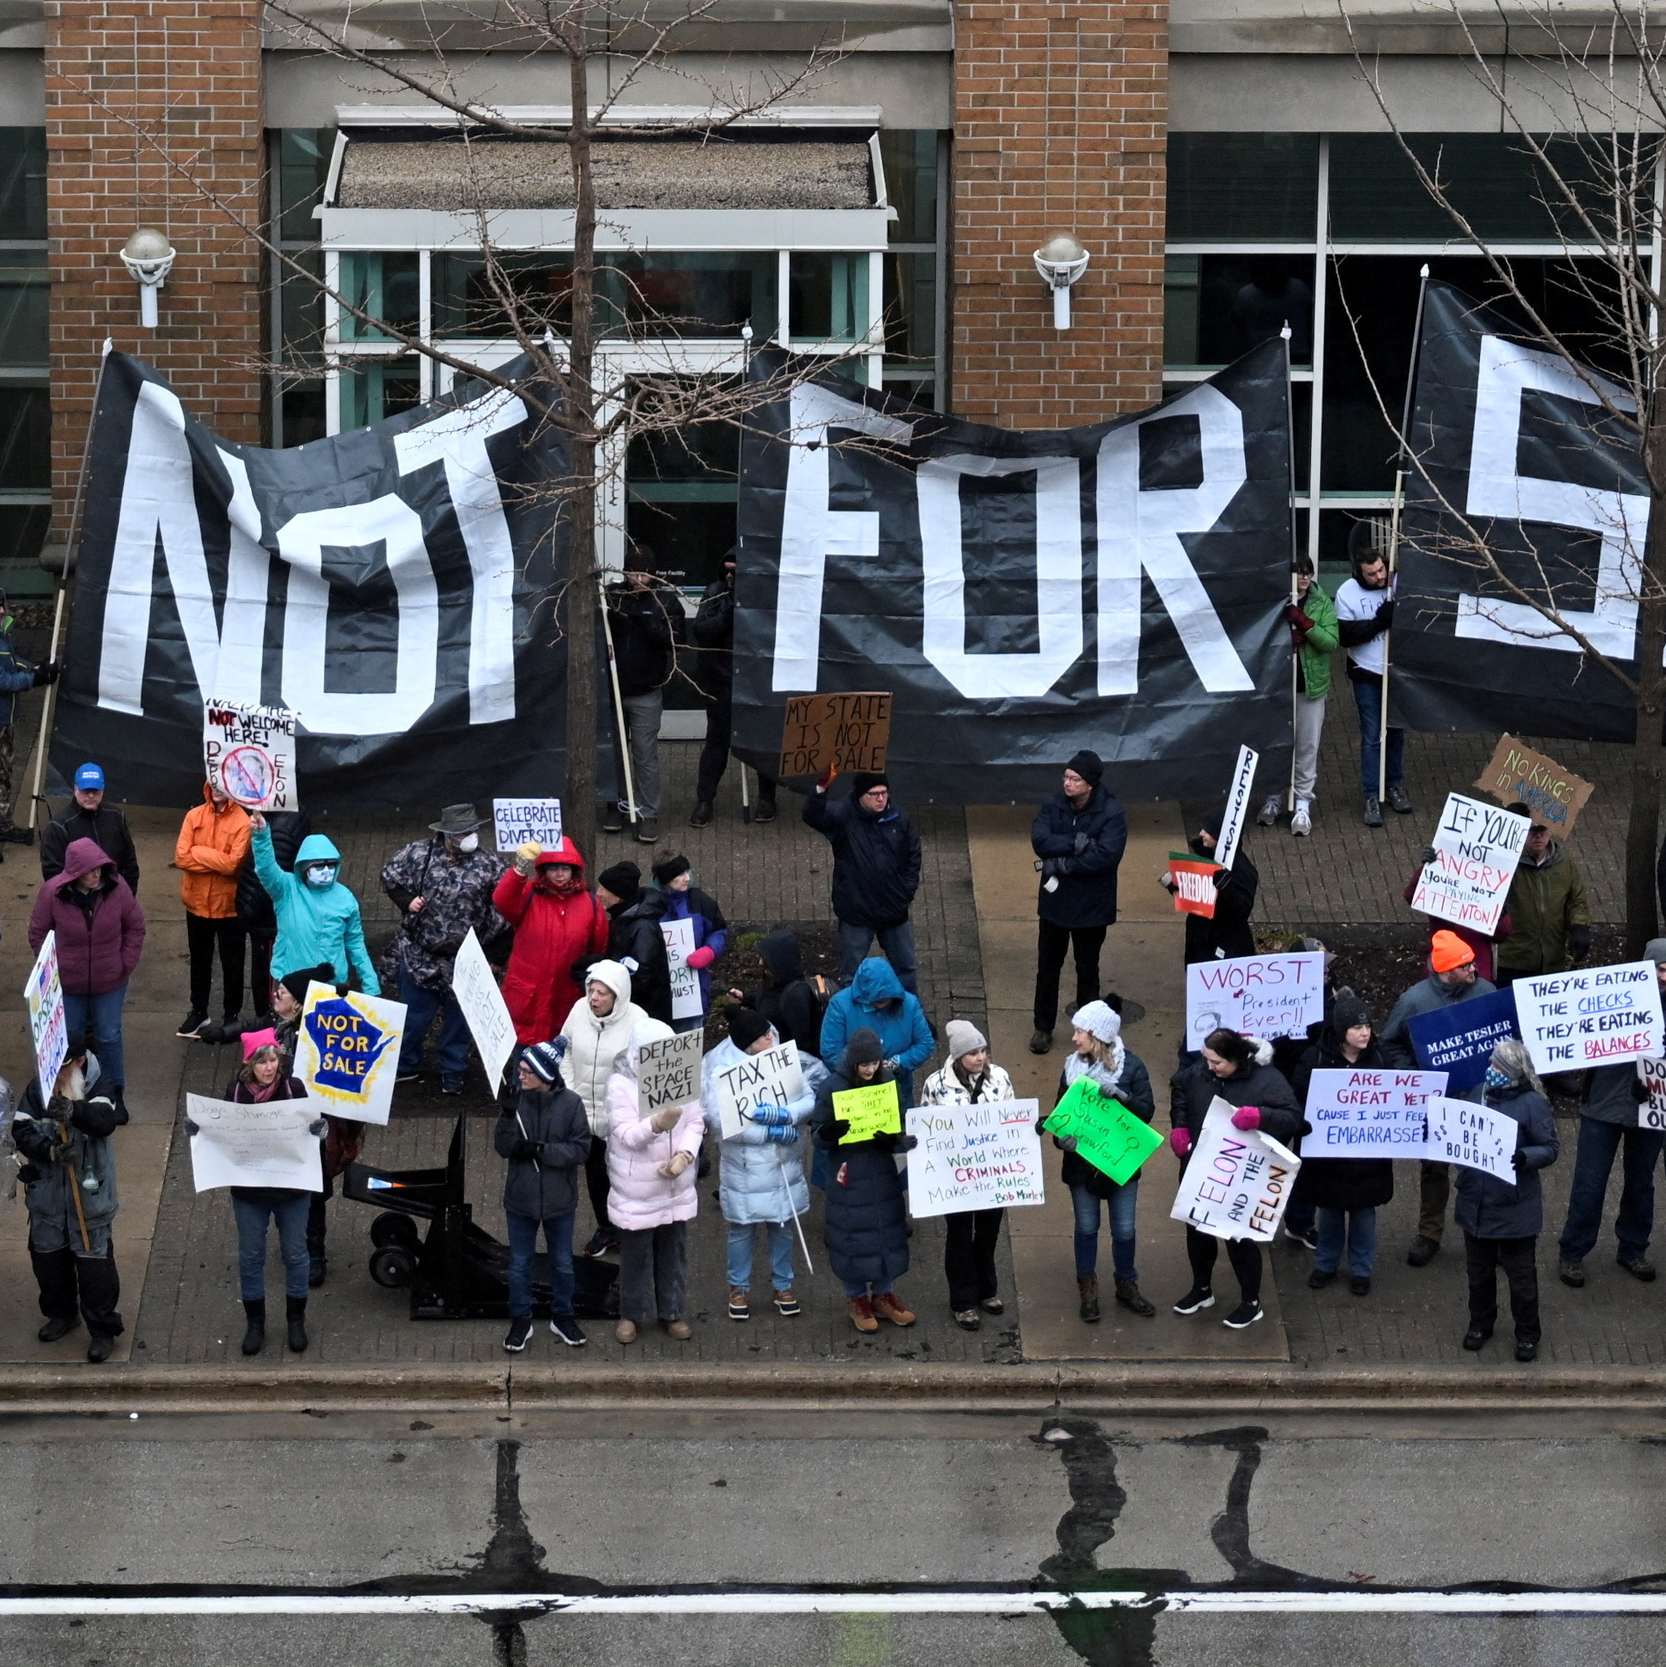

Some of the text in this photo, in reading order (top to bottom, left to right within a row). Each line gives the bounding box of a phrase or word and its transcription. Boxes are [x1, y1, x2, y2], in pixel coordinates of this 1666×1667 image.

[772, 381, 1255, 701] FOR
[97, 381, 528, 735] NOT
[208, 708, 295, 736] NOT WELCOME
[786, 695, 890, 724] MY STATE
[224, 725, 269, 748] HERE!
[799, 722, 876, 748] IS NOT
[782, 746, 885, 774] FOR SALE
[496, 806, 561, 823] CELEBRATE
[499, 829, 562, 845] DIVERSITY
[1459, 838, 1493, 864] NOT
[1436, 848, 1510, 892] ANGRY
[1444, 885, 1481, 904] PAYING
[1471, 884, 1496, 899] NOT
[1200, 960, 1312, 991] WORST
[1529, 970, 1648, 1002] THEY'RE EATING
[1539, 991, 1634, 1020] THE CHECKS
[317, 1014, 363, 1032] NOT
[1536, 1010, 1653, 1042] THEY'RE EATING
[327, 1035, 369, 1052] FOR
[1427, 1020, 1512, 1054] MAKE TESLER
[1546, 1030, 1651, 1062] THE BALANCES
[322, 1054, 367, 1075] SALE
[655, 1056, 683, 1072] the
[1432, 1046, 1482, 1067] GREAT
[641, 1064, 694, 1095] SPACE
[719, 1047, 793, 1096] TAX THE
[1347, 1073, 1422, 1087] ARE WE
[648, 1081, 693, 1109] NAZI
[1082, 1081, 1111, 1113] Vote
[1336, 1091, 1391, 1106] GREAT
[998, 1107, 1033, 1123] Never
[1073, 1101, 1111, 1137] Susan
[1373, 1110, 1398, 1121] JUST
[1460, 1110, 1495, 1136] CAN'T
[925, 1132, 998, 1152] Find Justice
[1463, 1130, 1478, 1147] BE
[925, 1152, 986, 1173] A World
[1242, 1151, 1265, 1183] THE
[1447, 1142, 1495, 1171] BOUGHT
[974, 1182, 994, 1193] the
[1249, 1164, 1289, 1234] FELON
[1227, 1192, 1249, 1222] AND
